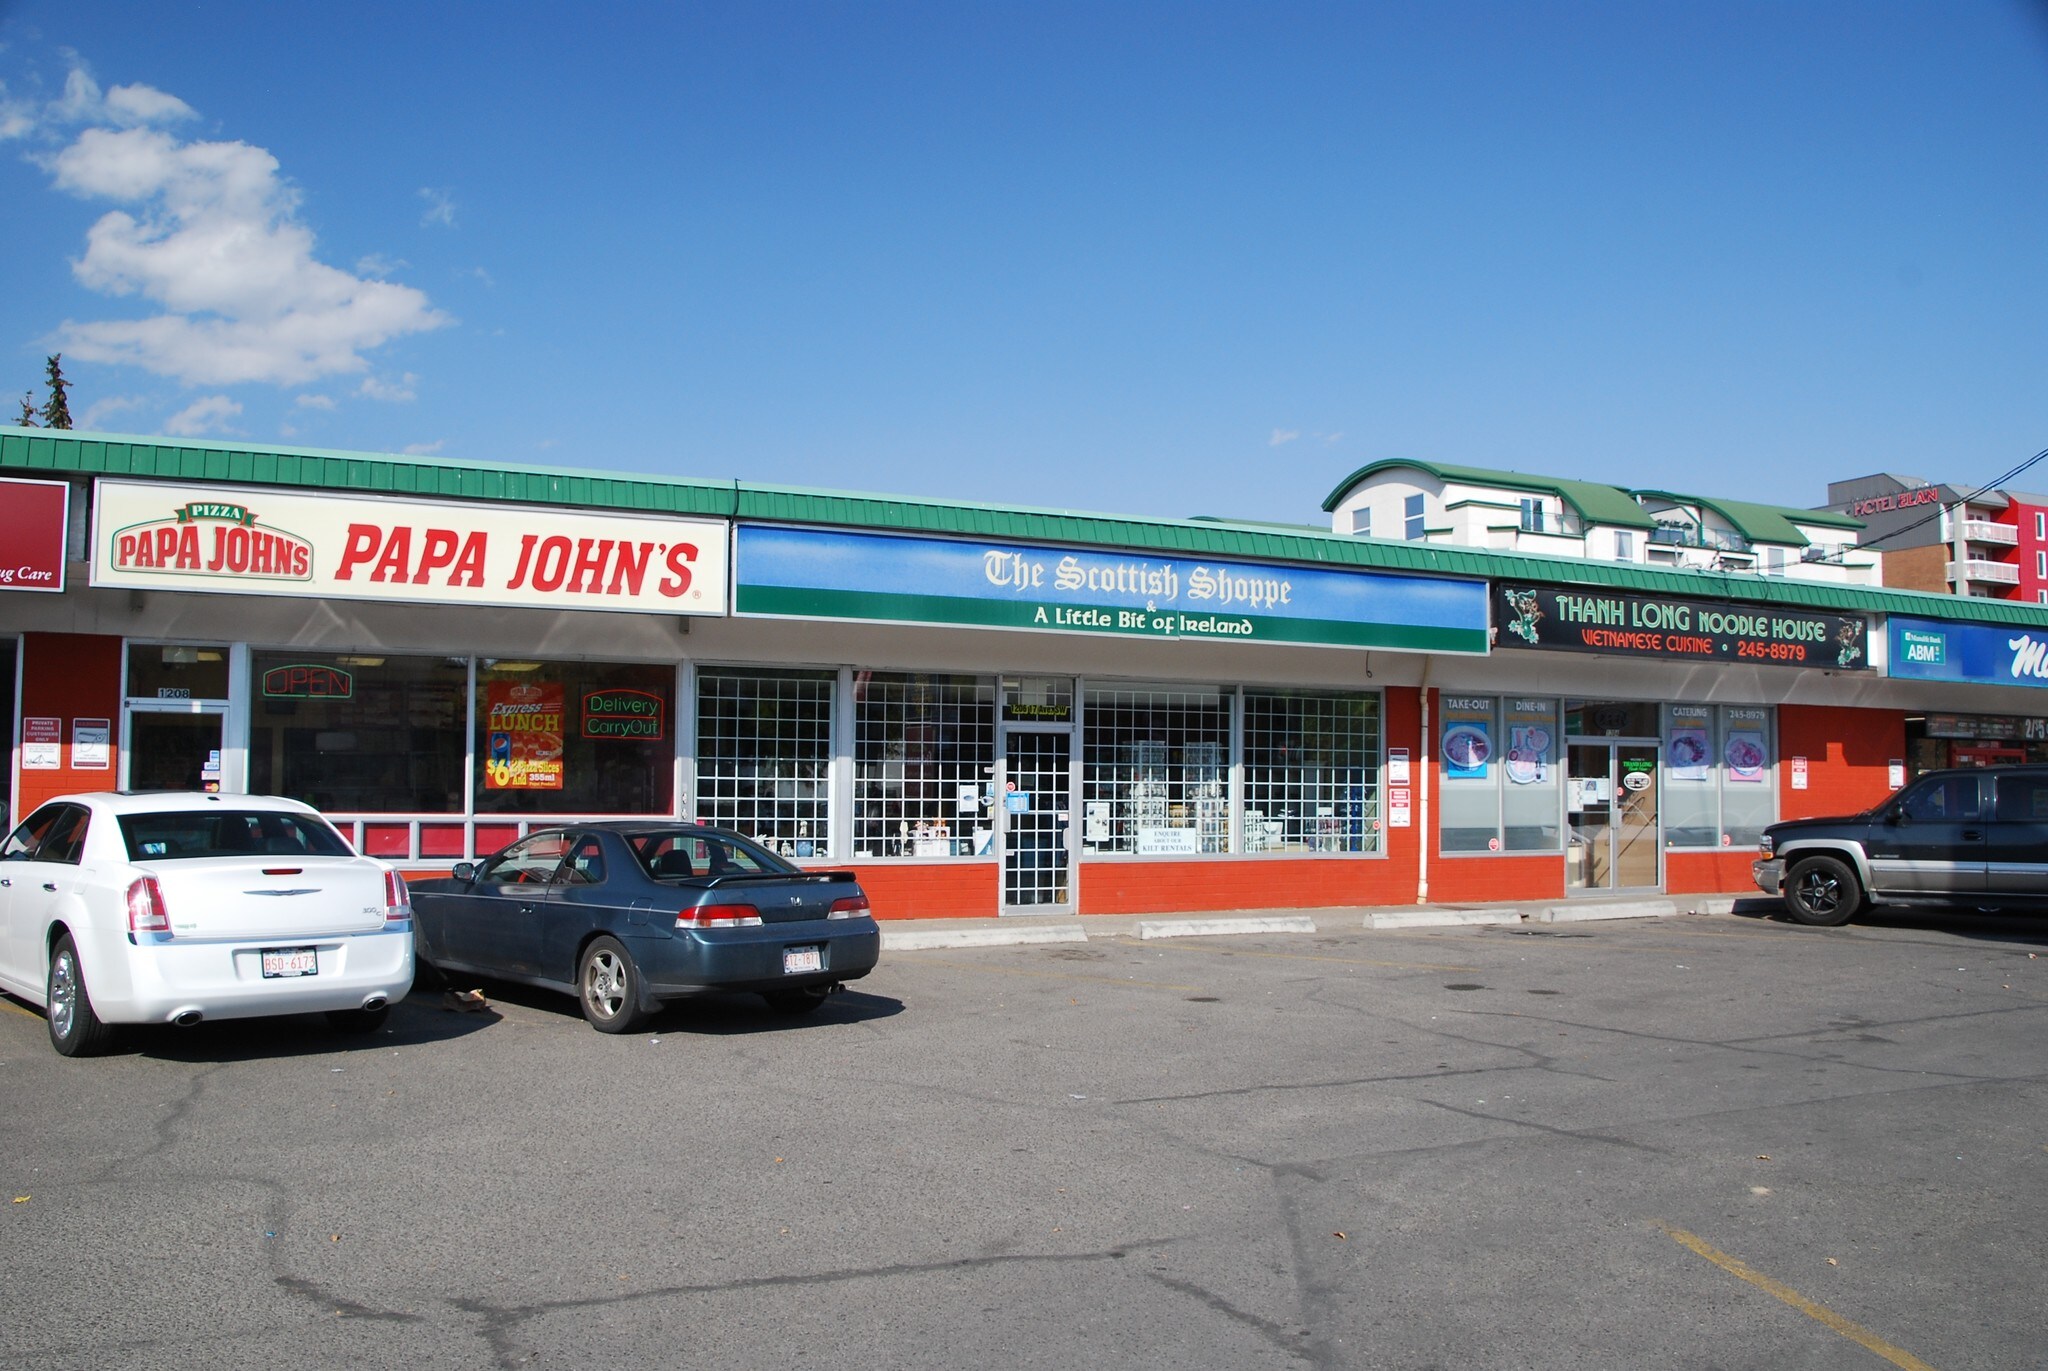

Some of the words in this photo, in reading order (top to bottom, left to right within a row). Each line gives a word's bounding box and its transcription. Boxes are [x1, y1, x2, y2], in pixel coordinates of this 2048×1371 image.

[1854, 496, 1896, 516] HOTEL
[1898, 487, 1939, 508] ELAN
[192, 504, 241, 519] PIZZA
[118, 526, 201, 569] PAPA
[208, 527, 309, 576] JOHN'S
[334, 523, 488, 588] PAPA
[507, 534, 699, 598] JOHN'S
[17, 566, 52, 580] Care
[983, 550, 1044, 592] The
[1054, 556, 1179, 601] Scottish
[1187, 566, 1292, 609] Shoppe
[1146, 600, 1157, 612] &
[1034, 607, 1048, 623] A
[1055, 607, 1111, 626] Little
[1119, 611, 1146, 628] Bit
[1152, 616, 1174, 634] of
[1180, 615, 1253, 634] Ireland
[1555, 595, 1625, 626] THANH
[1631, 602, 1690, 631] LONG
[1698, 612, 1767, 638] NOODLE
[1772, 618, 1826, 642] HOUSE
[1581, 629, 1662, 650] VIETNAMESE
[1666, 635, 1713, 654] CUISINE
[1737, 640, 1806, 661] 245-8979
[1907, 644, 1935, 661] ABM
[266, 669, 349, 695] OPEN
[159, 688, 189, 699] 1208
[490, 703, 543, 716] Express
[590, 696, 657, 716] Delivery
[1448, 699, 1489, 709] TAKE-OUT
[1516, 701, 1546, 712] DINE-IN
[1672, 707, 1707, 717] CATERING
[489, 714, 560, 731] LUNCH
[1729, 710, 1765, 719] 245-8979
[588, 719, 658, 737] CarryOut
[265, 955, 316, 971] BSD-6173
